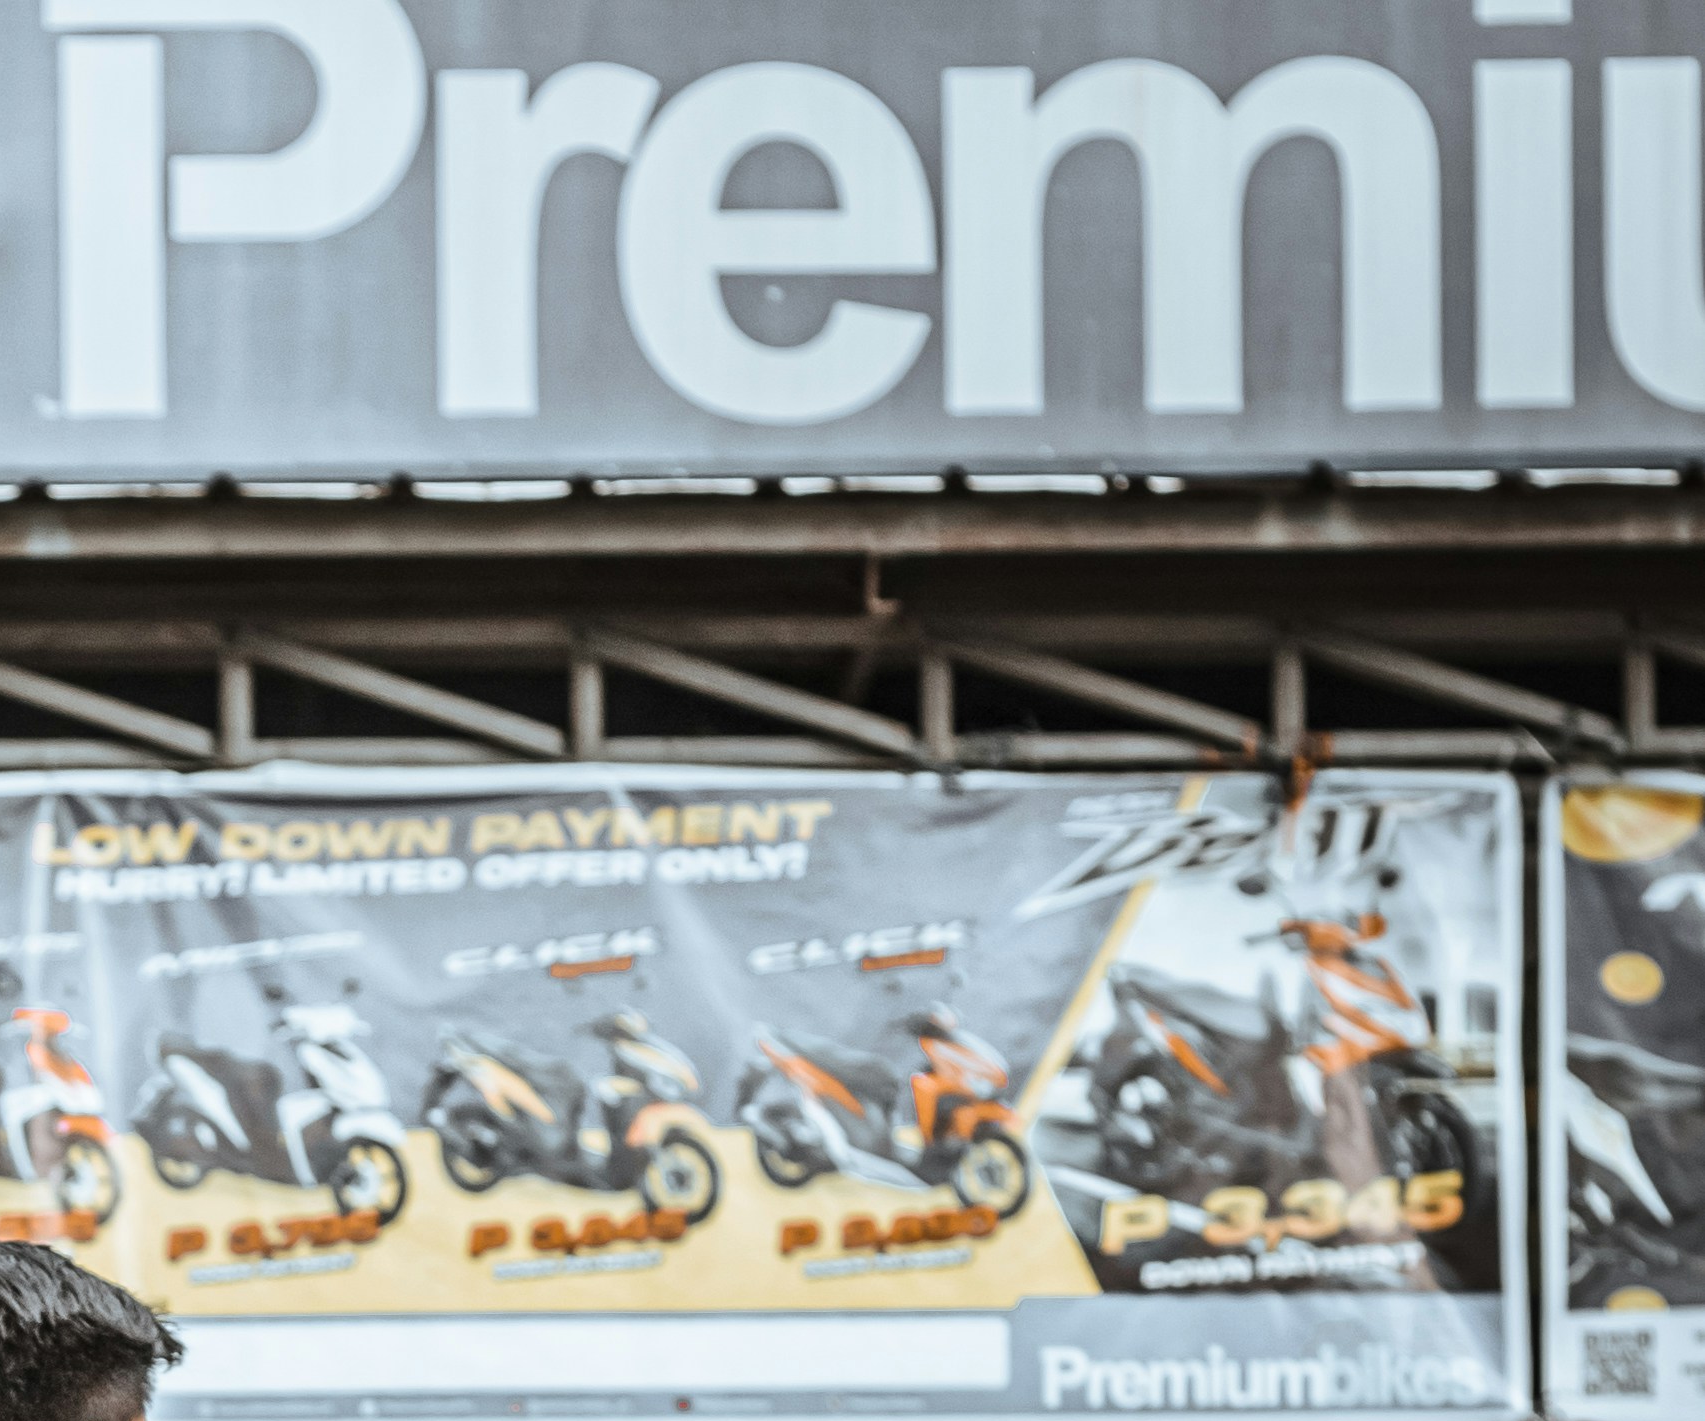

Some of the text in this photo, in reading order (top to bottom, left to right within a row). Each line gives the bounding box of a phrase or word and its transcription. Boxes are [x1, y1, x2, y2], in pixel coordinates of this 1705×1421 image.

[32, 802, 833, 866] LOW DOWN PAYMENT
[251, 855, 468, 897] LIMITED
[473, 849, 647, 890] OFFER
[1201, 1169, 1464, 1252] 3,345
